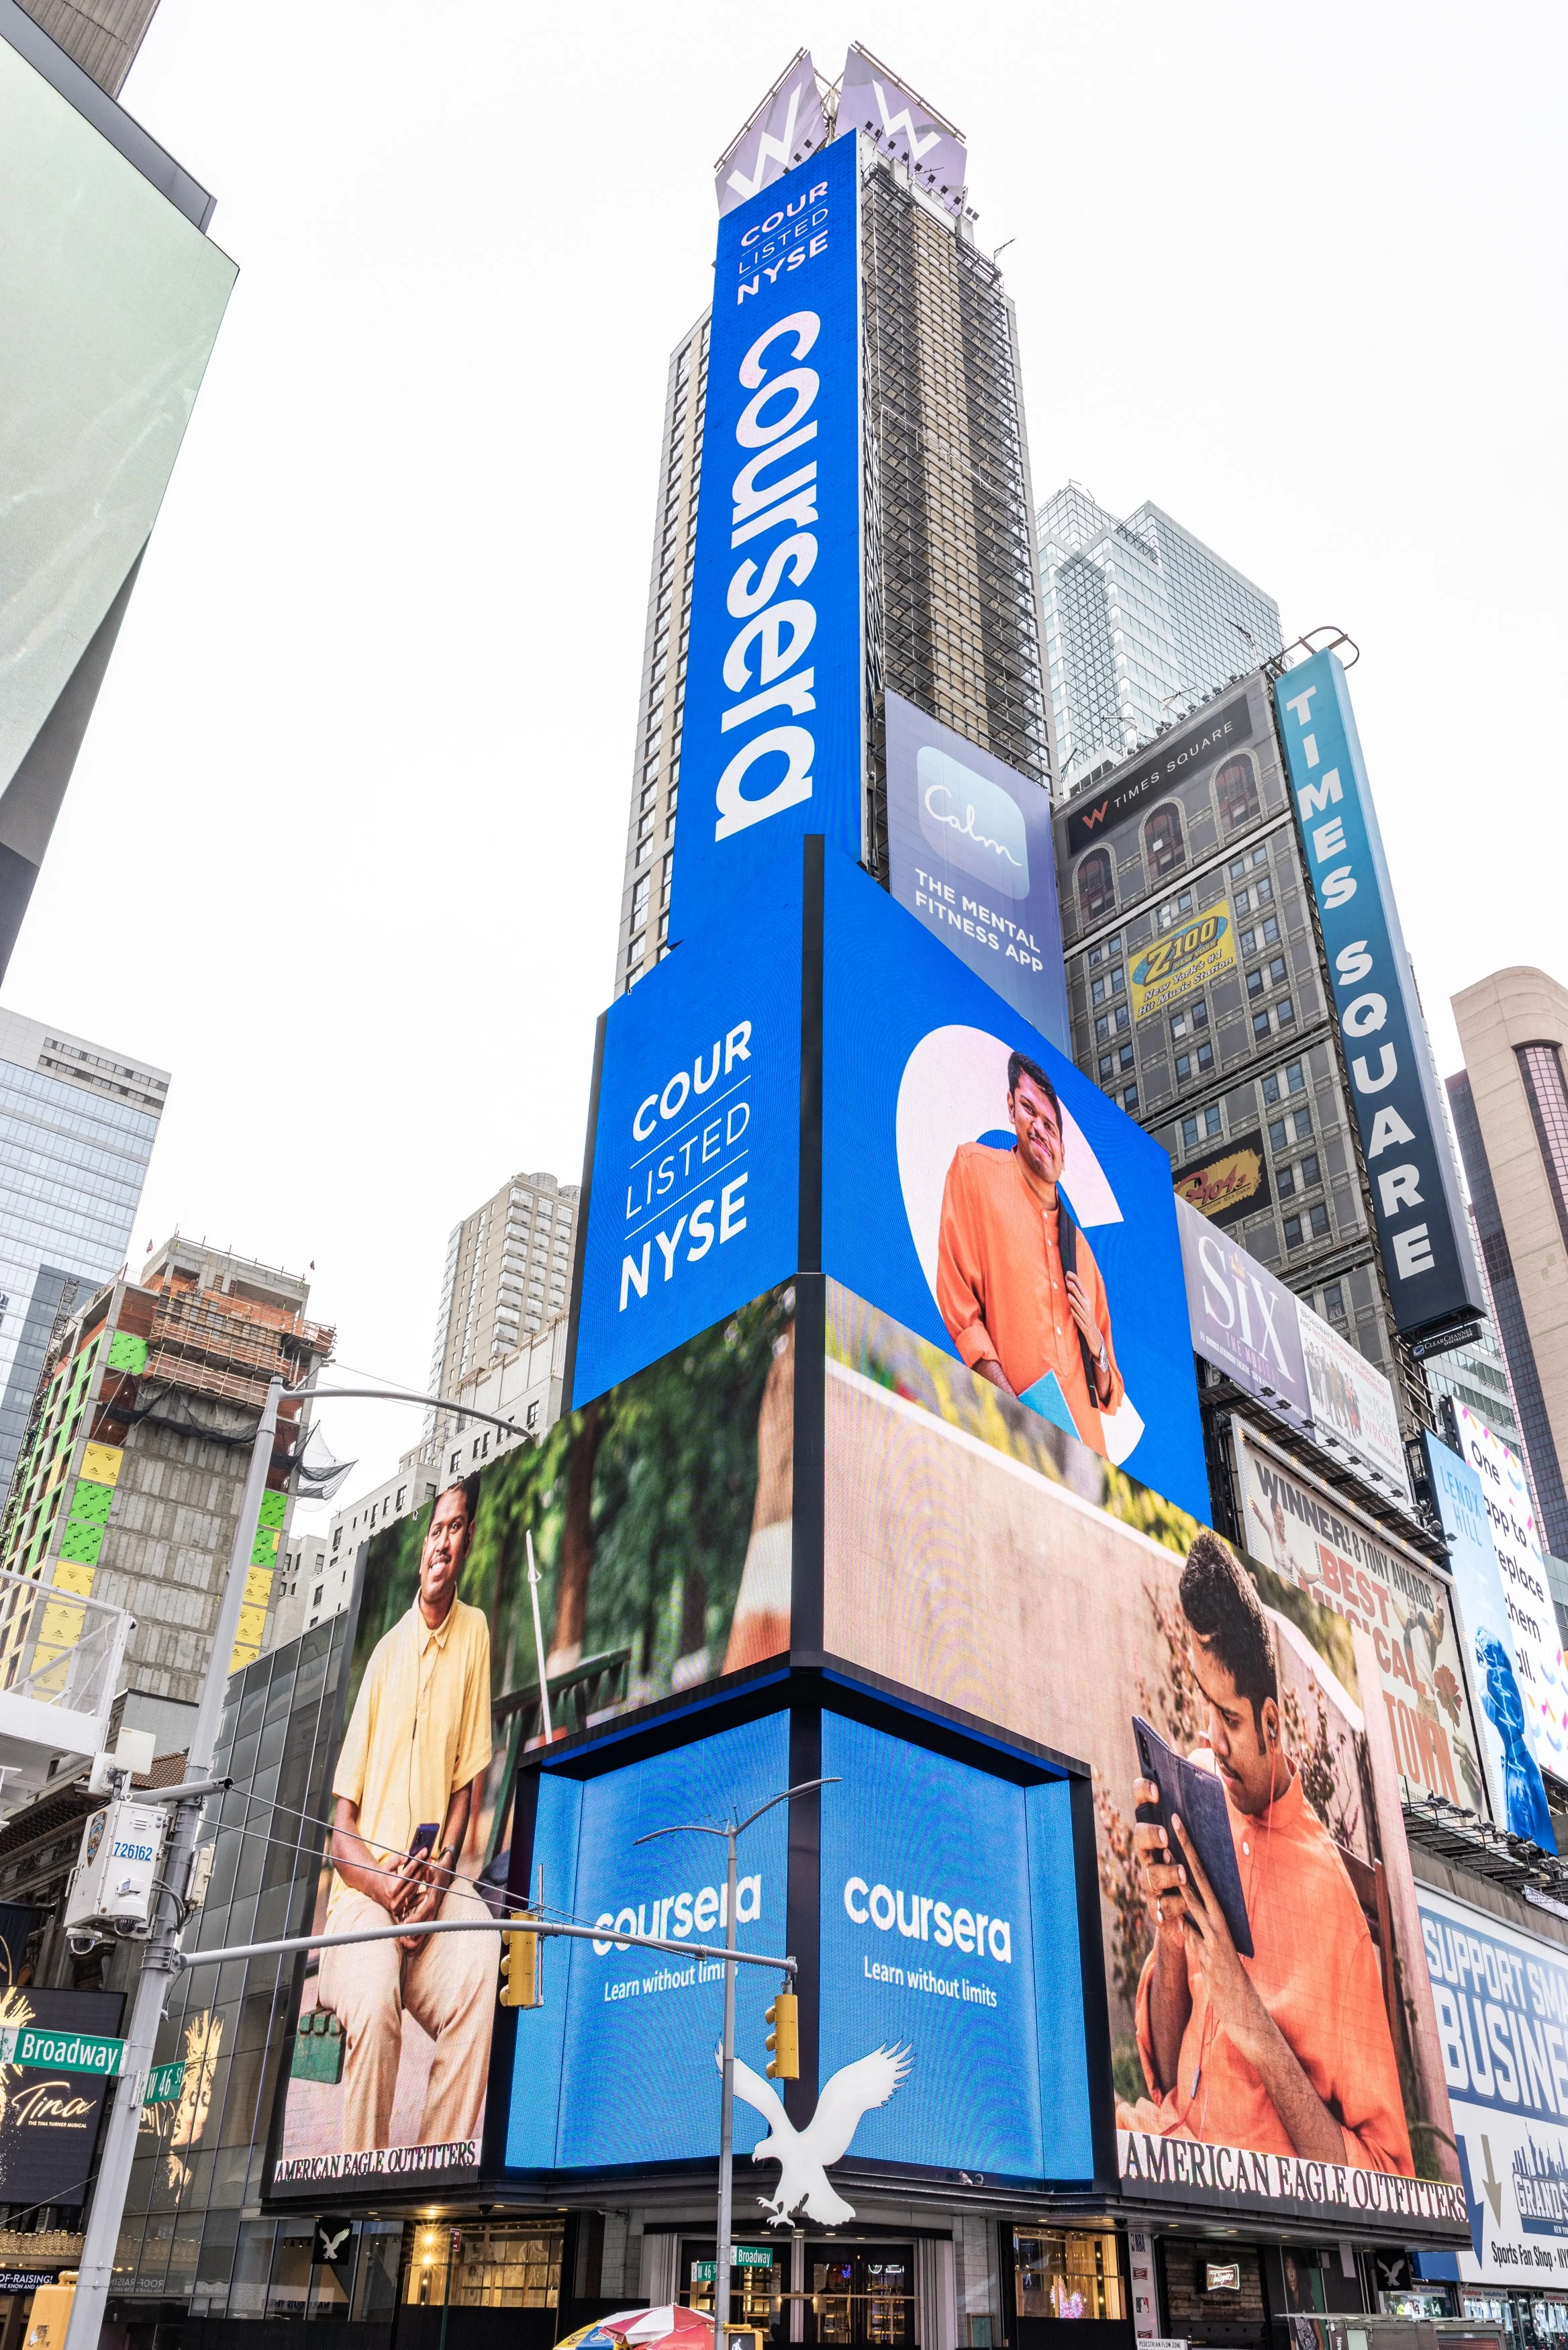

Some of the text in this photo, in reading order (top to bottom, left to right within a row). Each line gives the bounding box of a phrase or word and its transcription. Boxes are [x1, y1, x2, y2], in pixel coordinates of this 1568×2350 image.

[726, 81, 801, 200] W
[873, 79, 942, 161] W
[738, 208, 828, 275] LISTED
[741, 181, 828, 248] COUR
[737, 230, 828, 305] NYSE
[715, 311, 821, 842] coursera
[1081, 720, 1234, 830] W TIMES SQUARE
[1286, 685, 1358, 910] TIMES
[924, 784, 1022, 866] Calm
[916, 867, 1040, 953] THE MENTAL
[916, 890, 1043, 972] FITNESS APP
[1144, 916, 1218, 987] Z100
[1144, 949, 1222, 1002] New York's #1
[1173, 939, 1219, 970] NEW YORK
[1138, 957, 1234, 1018] Hit Music Station
[1336, 941, 1435, 1280] SQUARE
[1198, 1236, 1295, 1383] SIX
[1300, 1309, 1334, 1343] BROADWAY'S
[1226, 1331, 1280, 1387] THE MUSICAL
[1300, 1317, 1312, 1331] AND
[1312, 1328, 1355, 1372] INTERNATIONAL
[1444, 1332, 1473, 1346] SPECTACOLOR
[1361, 1413, 1402, 1466] WRONG
[1376, 1413, 1398, 1442] GOES
[1471, 1440, 1501, 1486] One
[1439, 1465, 1482, 1521] LENOX
[1254, 1458, 1353, 1557] WINNER!
[1351, 1530, 1361, 1563] 8
[1360, 1537, 1390, 1586] TONY
[1390, 1558, 1434, 1613] AWARDS
[1452, 1503, 1482, 1547] HILL
[1510, 1515, 1527, 1548] to
[1314, 1540, 1323, 1573] INCLUDING
[1494, 1545, 1545, 1603] eplace
[1318, 1542, 1389, 1628] BEST
[844, 1877, 1012, 1963] coursera
[604, 1980, 640, 2002] Learn
[642, 1965, 696, 1995] without
[864, 1955, 997, 2008] Learn without limits
[1421, 1916, 1528, 2012] SUPPORT
[21, 2034, 119, 2075] Broadway
[1430, 1981, 1568, 2116] BUSINE
[11, 2081, 97, 2126] Tina
[146, 2065, 184, 2100] W 46 St
[275, 2141, 477, 2183] AMERICAN EAGLE OUTFITTERS
[1123, 2132, 1469, 2222] AMERICAN EAGLE OUTFITTERS
[738, 2249, 771, 2267] Broadway
[1135, 2234, 1146, 2253] NBA
[1491, 2241, 1519, 2268] Sports
[1518, 2244, 1534, 2267] Fan
[1533, 2245, 1553, 2272] Shop
[1553, 2225, 1562, 2235] NEW
[697, 2265, 703, 2279] W
[704, 2264, 712, 2279] 46
[1431, 2302, 1442, 2316] 14
